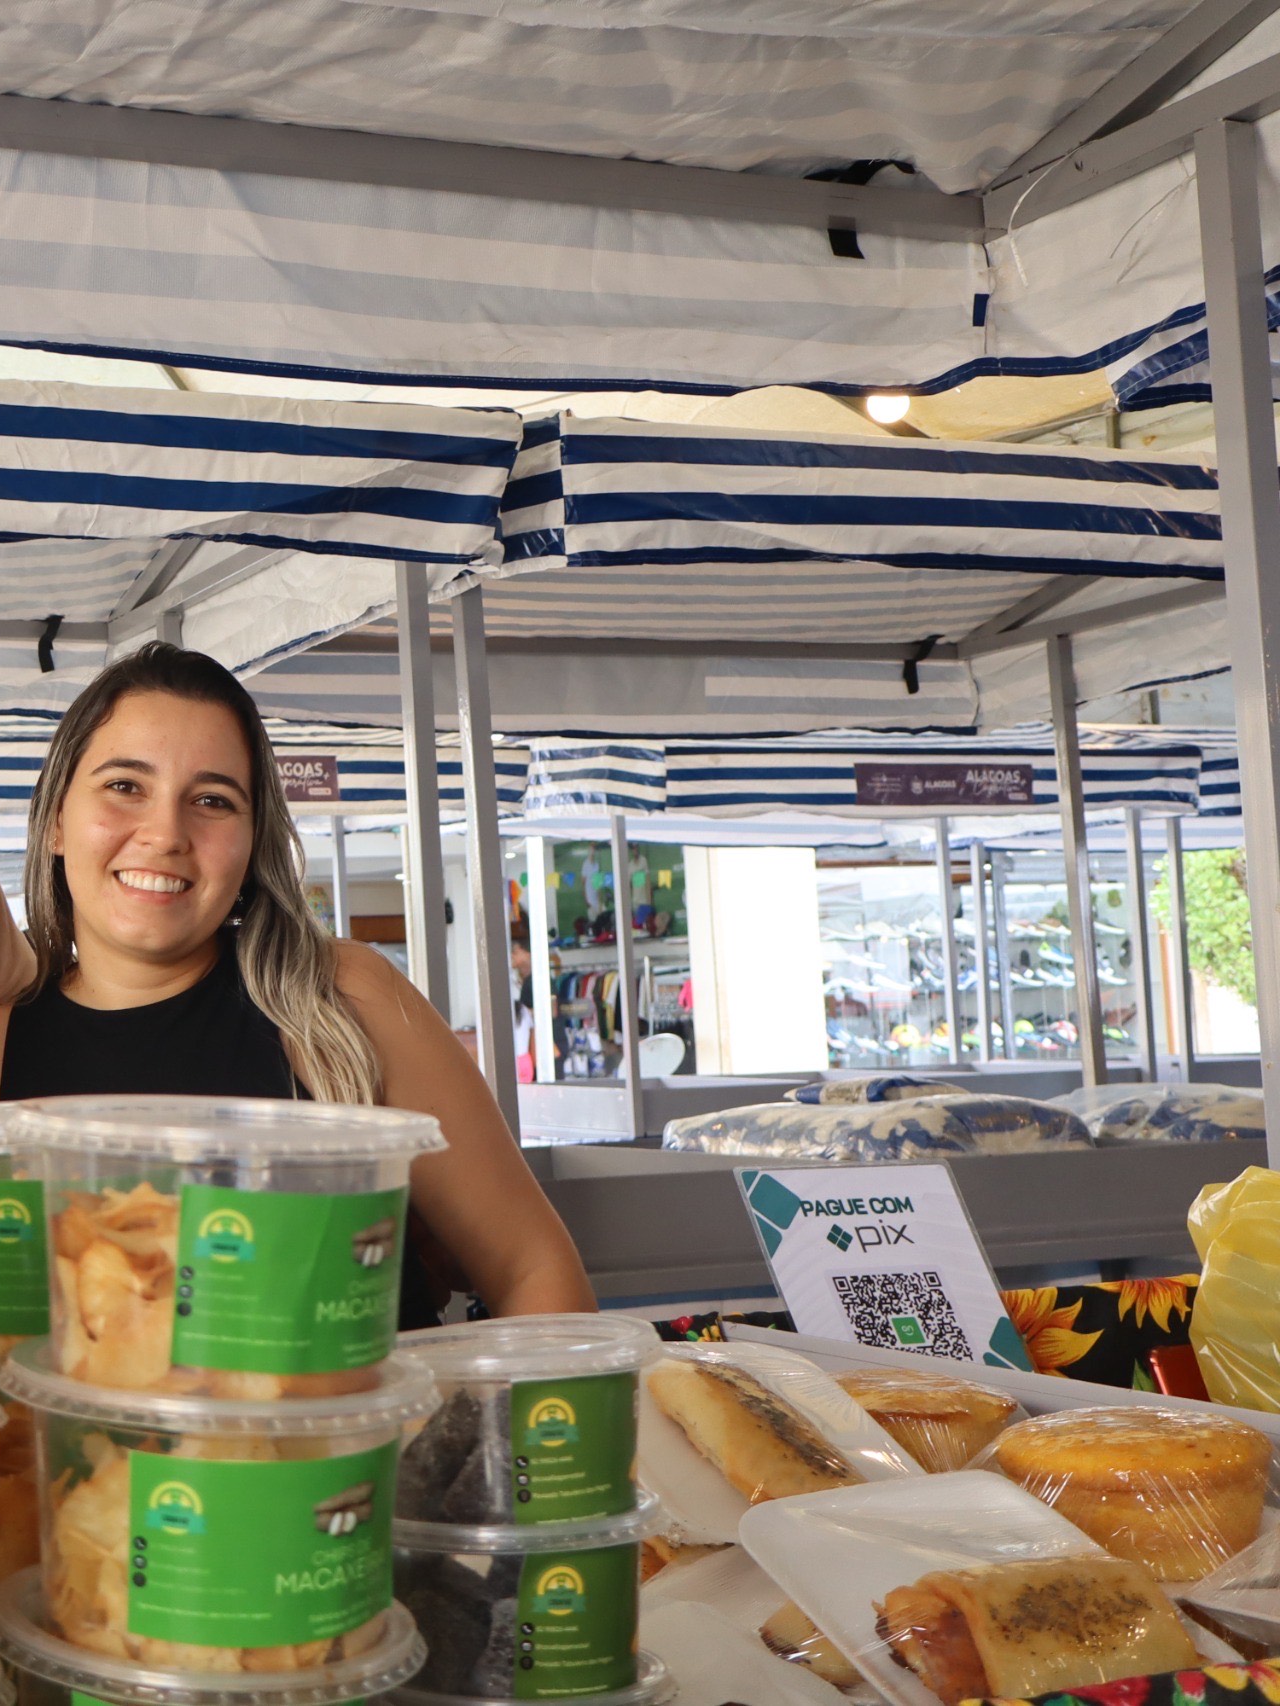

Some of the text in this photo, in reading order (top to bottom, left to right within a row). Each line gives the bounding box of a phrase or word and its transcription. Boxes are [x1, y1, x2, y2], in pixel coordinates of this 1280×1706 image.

[276, 761, 324, 777] AGOAS
[965, 769, 1021, 783] ALAGOAS
[800, 1196, 915, 1217] PAGUE COM
[854, 1219, 916, 1254] pix
